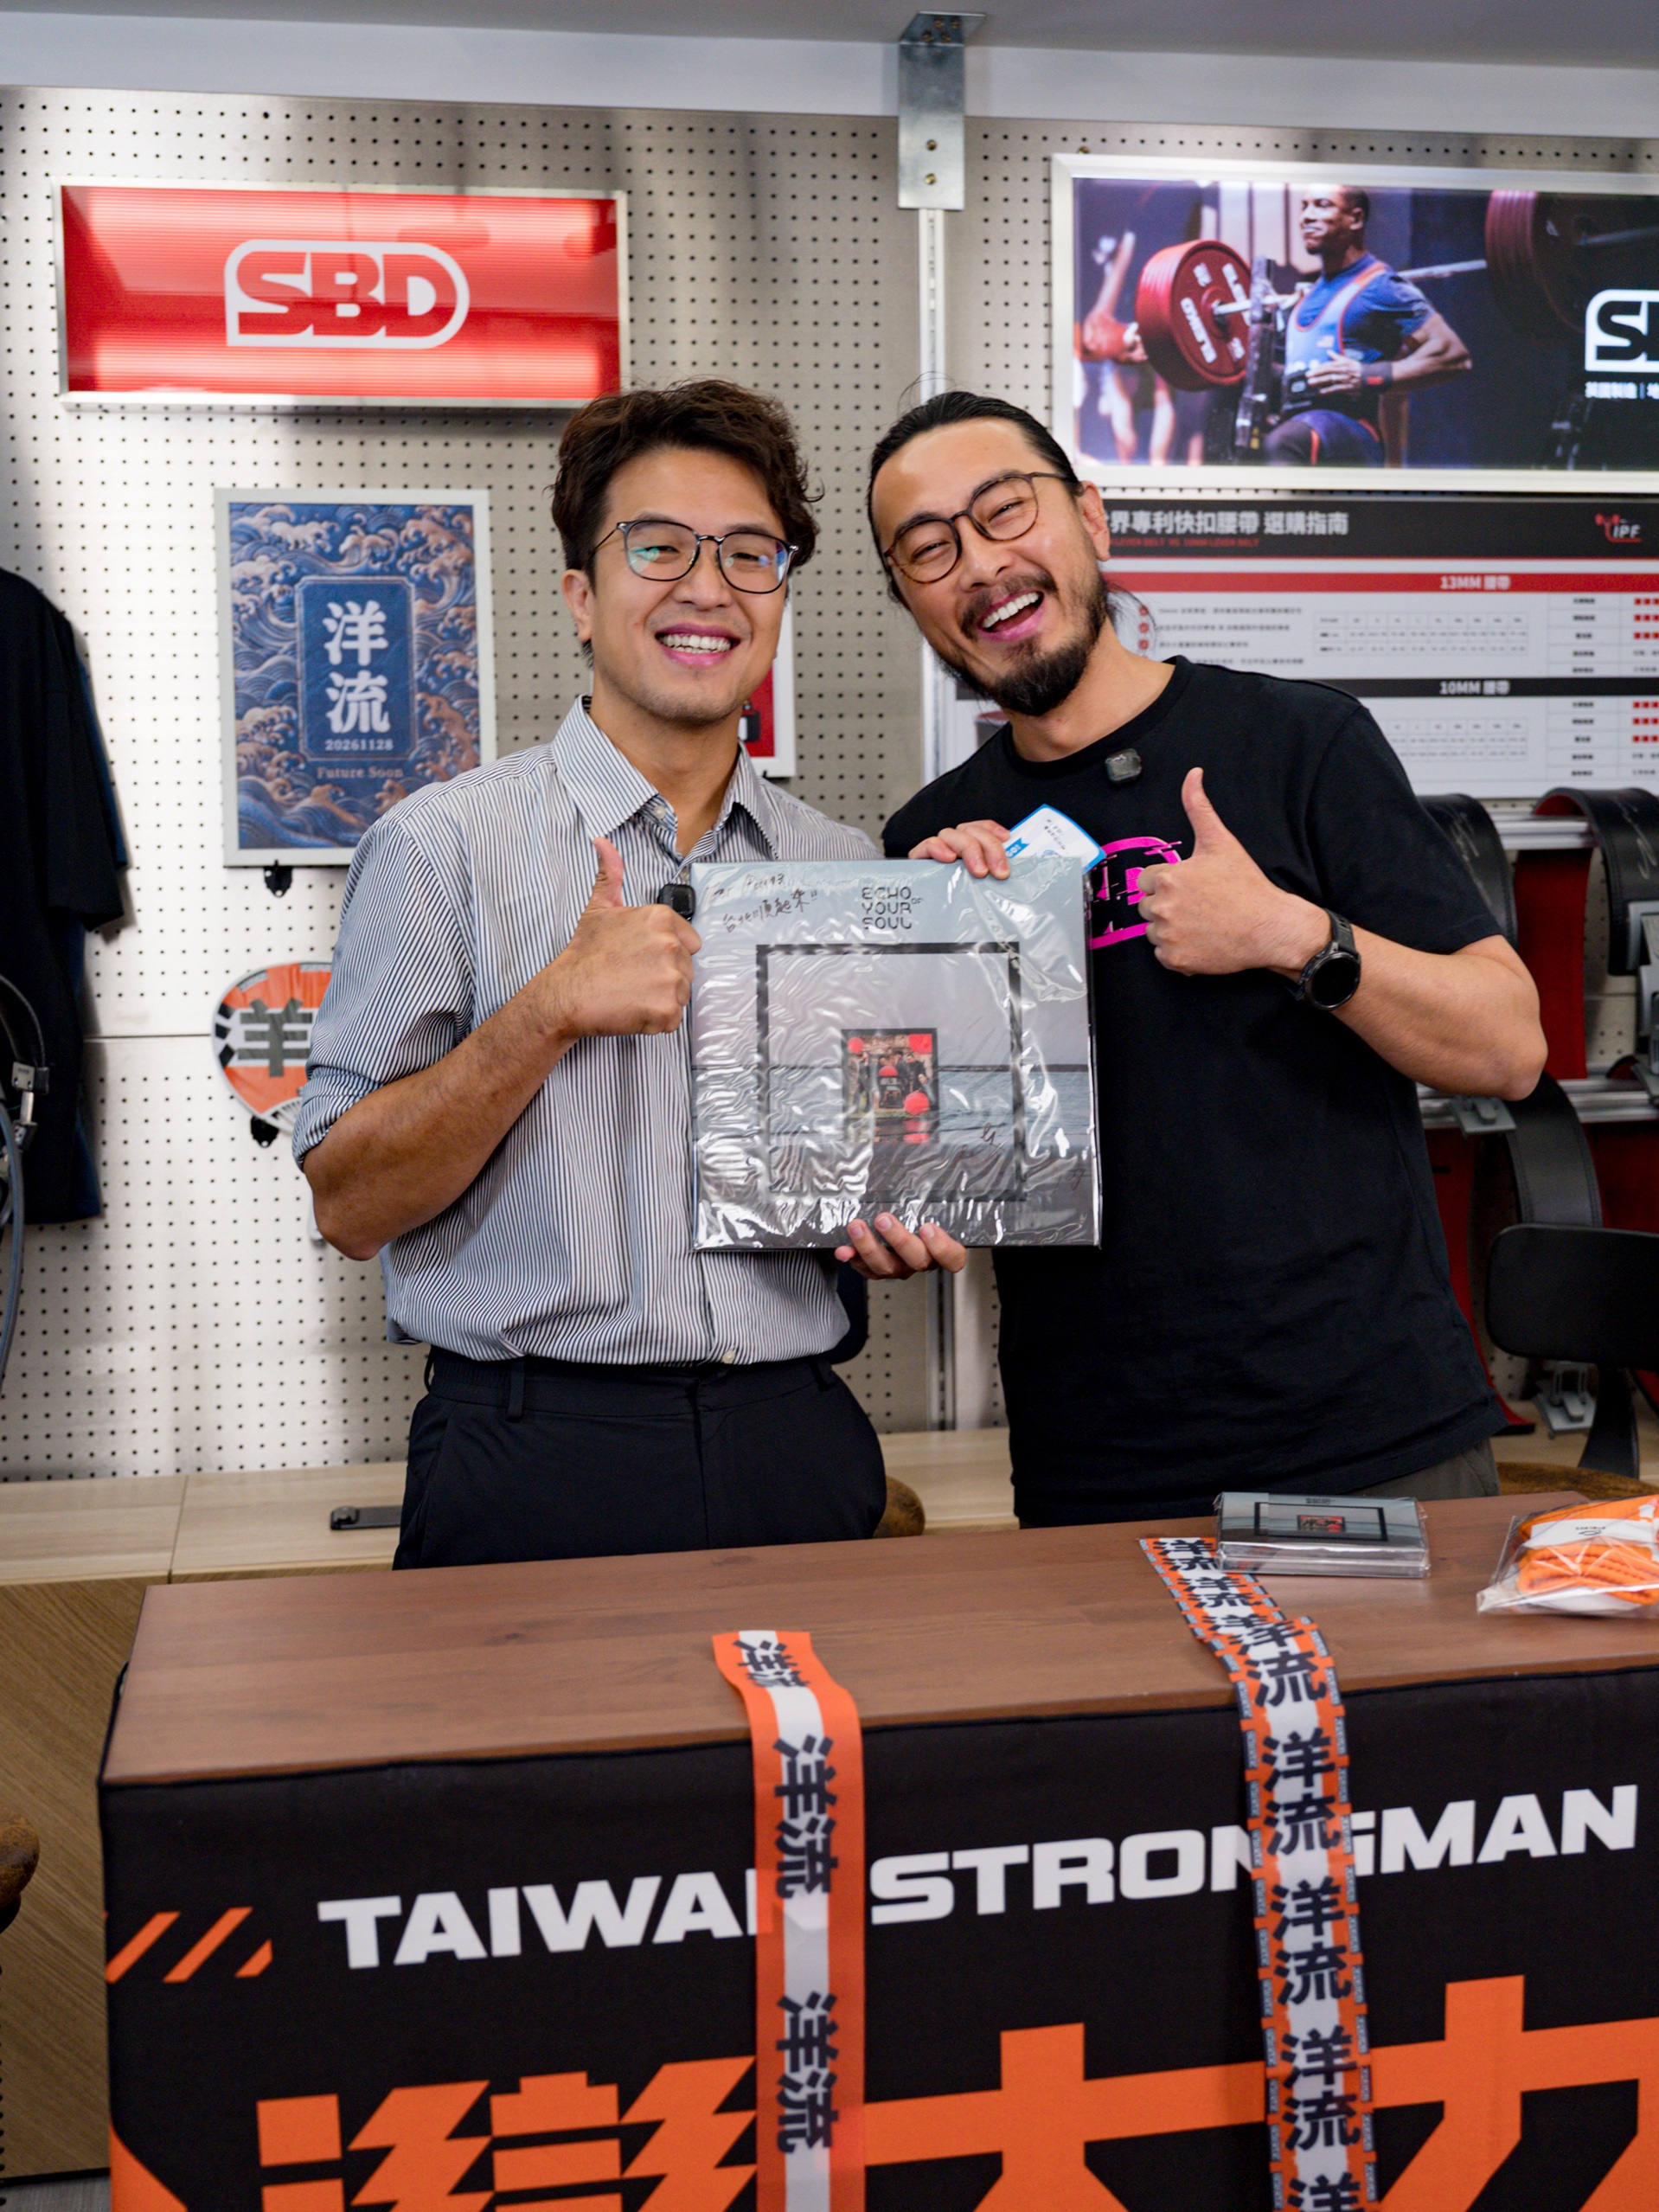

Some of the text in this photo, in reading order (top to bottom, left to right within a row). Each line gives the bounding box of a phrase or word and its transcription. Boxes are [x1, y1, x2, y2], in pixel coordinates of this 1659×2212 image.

[230, 245, 463, 343] SBD
[1106, 510, 1259, 535] 界專利快扣腰帶
[1613, 524, 1641, 538] IPF
[1440, 575, 1481, 589] 13MM
[323, 600, 391, 734] 洋流
[1439, 680, 1480, 695] 10MM
[317, 766, 404, 779] Future Soon
[862, 887, 912, 900] ECHO
[862, 902, 912, 914] YOUR
[862, 917, 913, 930] SOUL
[772, 1734, 838, 1899] 洋流
[1261, 1728, 1341, 1855] 洋流
[318, 1784, 1637, 1969] TAIWA STRONMAN
[1271, 1875, 1352, 2004] 洋流
[776, 1991, 839, 2153] 洋流
[1280, 2025, 1361, 2151] 洋流
